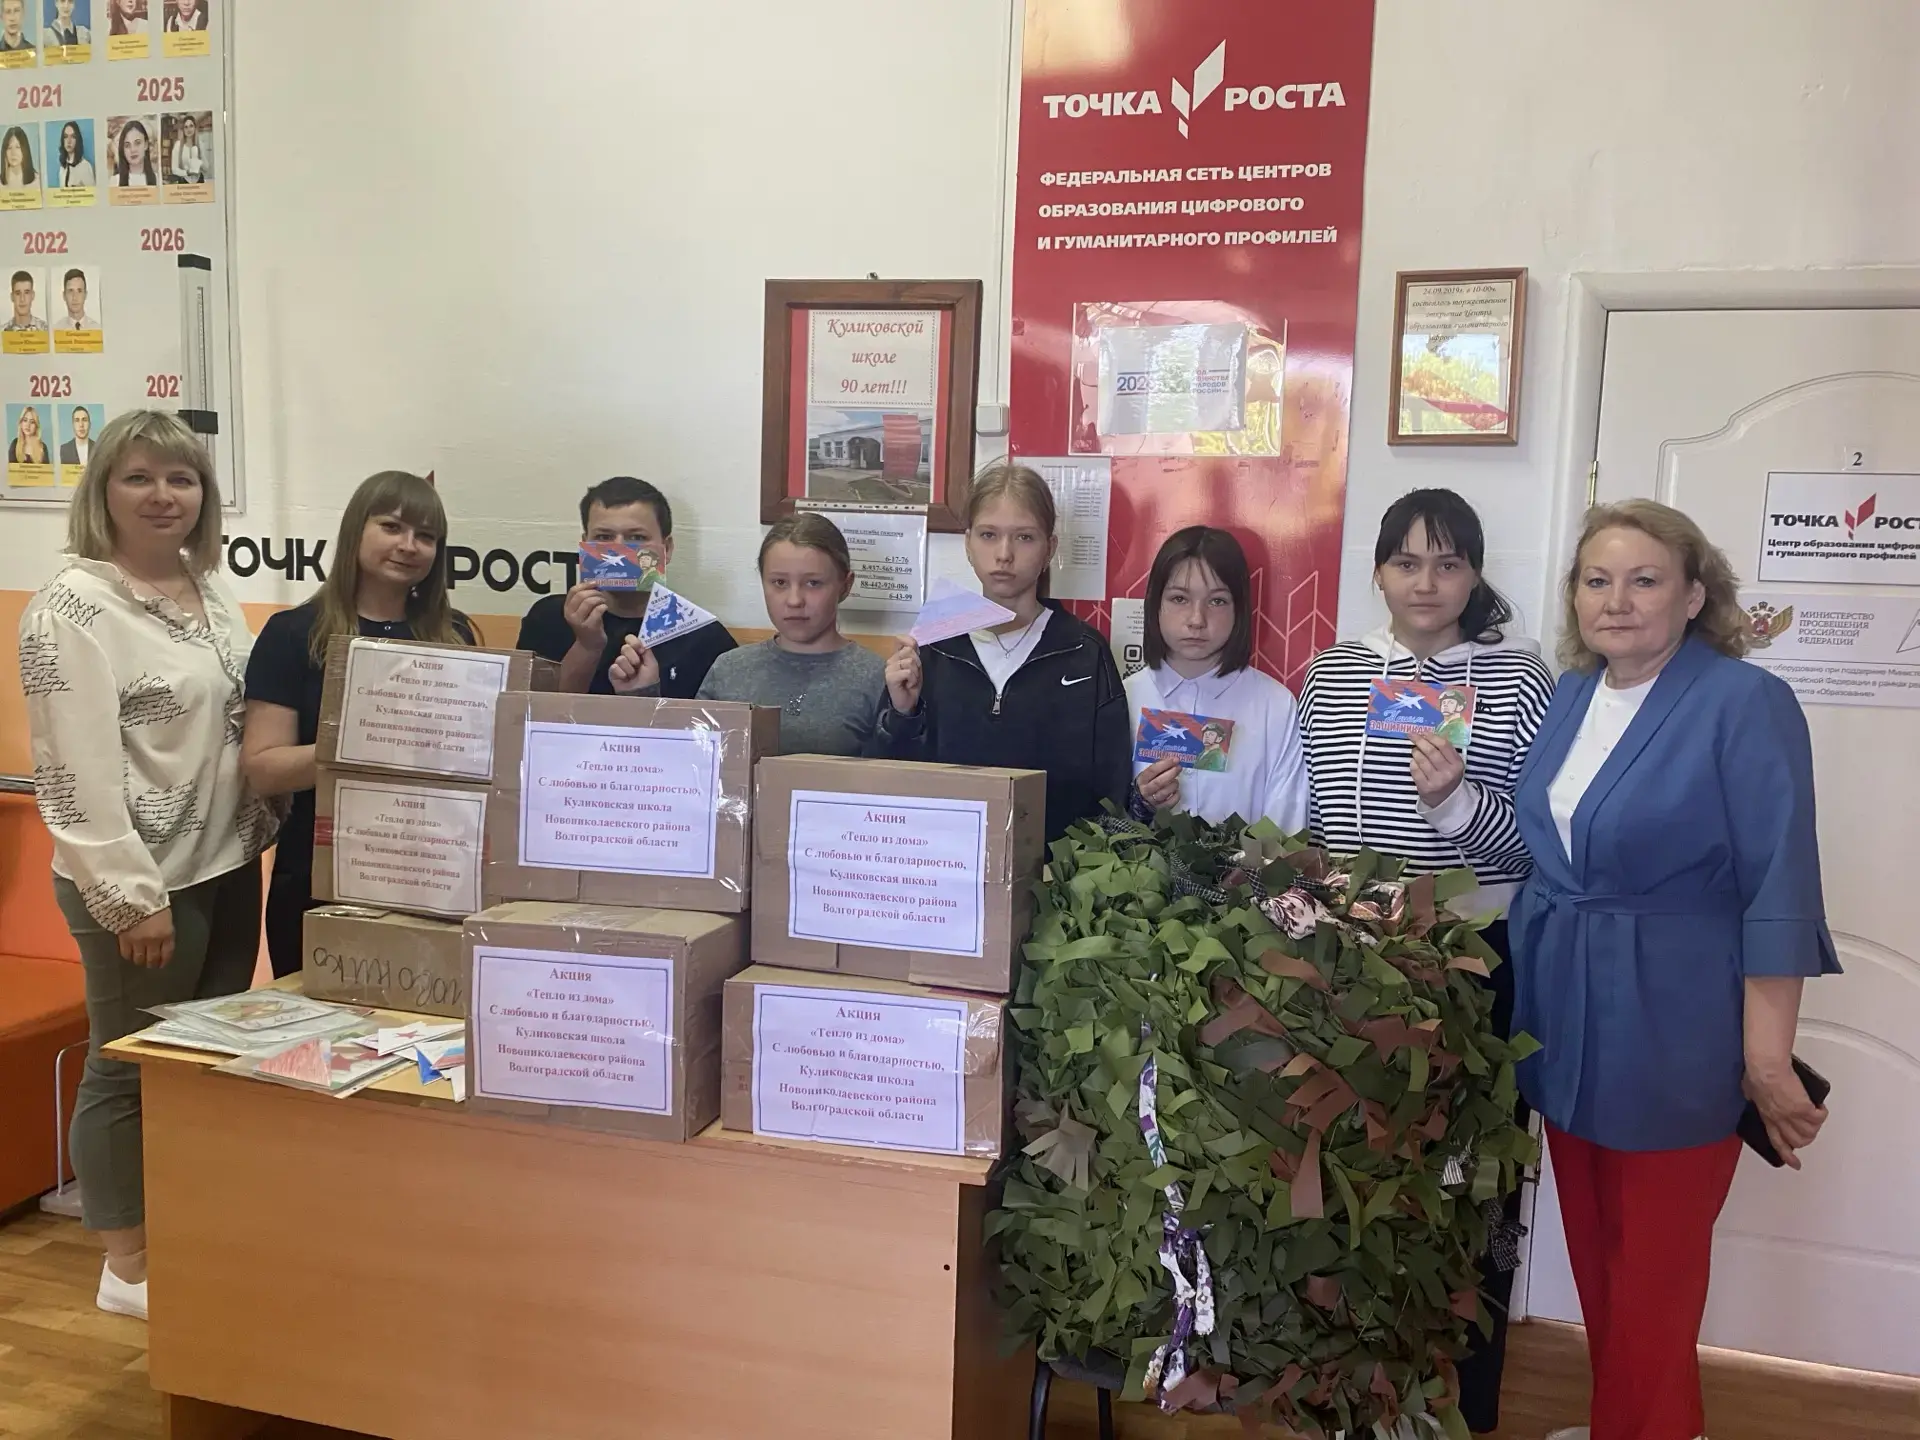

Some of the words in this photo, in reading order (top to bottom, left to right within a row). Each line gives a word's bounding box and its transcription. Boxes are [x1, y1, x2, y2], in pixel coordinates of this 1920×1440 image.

[17, 84, 62, 109] 2021
[137, 77, 185, 101] 2025
[1043, 90, 1162, 119] ТОЧКА
[1224, 82, 1346, 111] РОСТА
[1040, 168, 1182, 187] ФЕДЕРАЛЬНАЯ
[1186, 166, 1234, 183] СЕТЬ
[1238, 163, 1332, 182] ЦЕНТРОВ
[1038, 200, 1177, 218] ОБРАЗОВАНИЯ
[1181, 197, 1304, 215] ЦИФРОВОГО
[23, 231, 68, 254] 2022
[140, 228, 185, 251] 2026
[1037, 236, 1051, 250] И
[1054, 231, 1220, 249] ГУМАНИТАРНОГО
[1224, 226, 1338, 246] ПРОФИЛЕЙ
[827, 318, 924, 338] Куликовской
[851, 351, 897, 367] школе
[30, 375, 72, 397] 2023
[840, 378, 858, 394] 90
[861, 380, 907, 394] лет!!!
[1853, 452, 1863, 466] 2
[1770, 514, 1839, 528] ТОЧКА
[1874, 516, 1920, 530] РОСТ
[1768, 539, 1801, 548] Центр
[1804, 539, 1875, 550] образования
[1877, 542, 1920, 551] цифров
[1776, 550, 1857, 560] гуманитарного
[1859, 551, 1916, 561] профилей
[221, 535, 328, 582] ОЧК
[446, 546, 580, 595] РОСТ
[1799, 620, 1869, 629] ПРОСВЕЩЕНИЯ
[1800, 611, 1875, 620] МИНИСТЕРСТВО
[1798, 637, 1854, 646] ФЕДЕРАЦИИ
[1799, 629, 1860, 637] РОССИЙСКОЙ
[599, 741, 640, 754] Акция
[576, 761, 613, 772] «Тепло
[630, 765, 664, 774] дома»
[538, 777, 547, 786] С
[549, 779, 597, 789] любовью
[609, 782, 701, 796] благодарностью,
[392, 798, 426, 810] Акция
[564, 797, 634, 810] Куликовская
[637, 803, 672, 812] школа
[375, 814, 404, 823] «Тепло
[416, 820, 441, 828] дома»
[545, 814, 649, 830] Новониколаевского
[652, 823, 691, 832] района
[864, 811, 906, 824] Акция
[354, 829, 390, 839] любовью
[399, 831, 469, 848] благодарностью,
[555, 831, 633, 845] Волгоградской
[636, 837, 678, 847] области
[841, 831, 879, 843] «Тепло
[895, 837, 928, 846] дома»
[364, 844, 418, 858] Куликовская
[420, 852, 446, 861] школа
[805, 848, 813, 857] С
[814, 850, 862, 861] любовью
[874, 853, 967, 869] благодарностью,
[351, 858, 430, 874] Новониколаевского
[432, 868, 460, 878] района
[359, 872, 419, 886] Волгоградской
[421, 879, 451, 890] области
[829, 869, 899, 883] Куликовская
[902, 877, 937, 887] школа
[812, 886, 915, 904] Новониколаевского
[918, 897, 957, 908] района
[823, 903, 899, 920] Волгоградской
[902, 912, 946, 924] области
[549, 968, 592, 982] Акция
[526, 989, 565, 1001] «Тепло
[582, 995, 615, 1005] дома»
[489, 1005, 498, 1014] С
[500, 1007, 549, 1019] любовью
[562, 1012, 655, 1028] благодарностью,
[836, 1007, 881, 1021] Акция
[516, 1026, 588, 1041] Куликовская
[591, 1035, 625, 1045] школа
[810, 1028, 852, 1039] «Тепло
[855, 1033, 868, 1041] из
[870, 1035, 905, 1044] дома»
[498, 1044, 605, 1062] Новониколаевского
[608, 1055, 645, 1067] района
[772, 1043, 780, 1052] С
[784, 1045, 835, 1057] любовью
[848, 1050, 944, 1071] благодарностью,
[509, 1062, 589, 1077] Волгоградской
[592, 1070, 634, 1082] области
[800, 1065, 873, 1082] Куликовская
[877, 1076, 914, 1087] школа
[779, 1083, 891, 1102] Новониколаевского
[895, 1096, 936, 1106] района
[791, 1101, 874, 1118] Волгоградской
[878, 1110, 924, 1122] области
